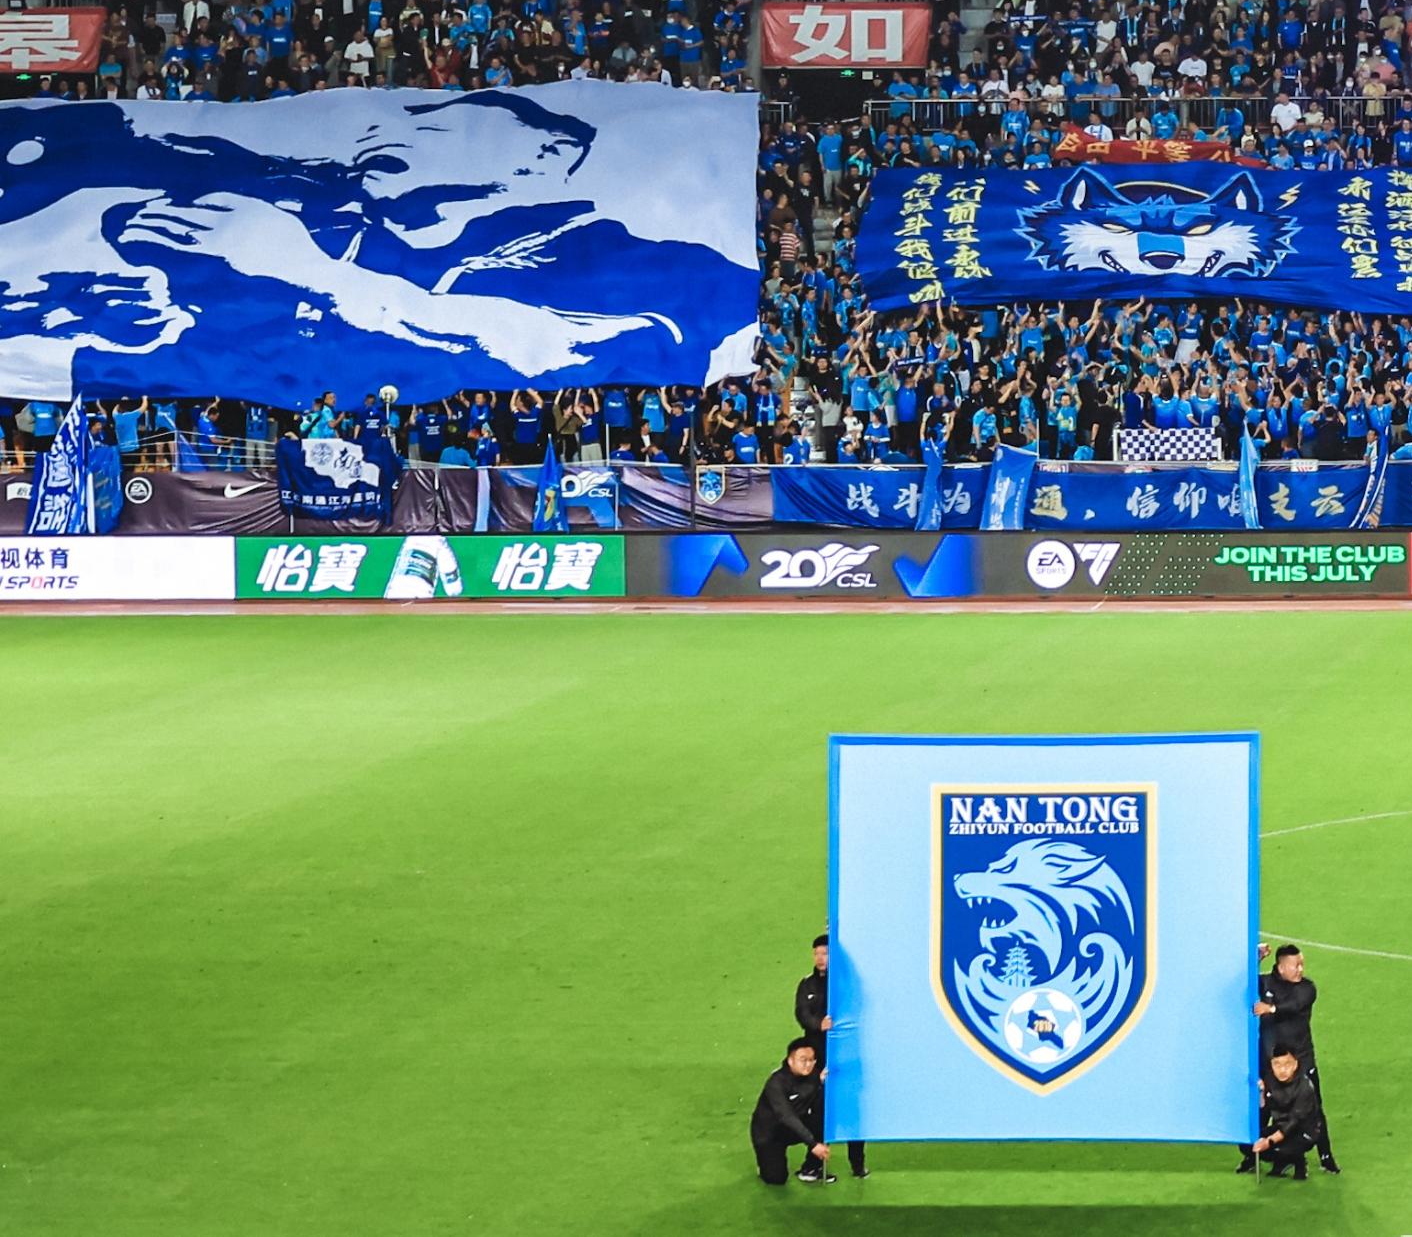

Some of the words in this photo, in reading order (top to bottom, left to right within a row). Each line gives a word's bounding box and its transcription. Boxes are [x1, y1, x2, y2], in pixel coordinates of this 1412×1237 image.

[789, 5, 903, 63] 如
[1037, 551, 1065, 566] EA
[1215, 546, 1280, 564] JOIN
[1281, 546, 1329, 564] THE
[1331, 546, 1405, 564] CLUB
[256, 543, 367, 593] 怡寶
[491, 542, 603, 591] 怡寶
[1248, 565, 1310, 582] THIS
[1311, 565, 1377, 582] JULY
[5, 575, 79, 589] SPORTS
[836, 572, 877, 588] CSL
[950, 796, 1028, 823] NAN
[1039, 796, 1139, 823] TONG
[949, 822, 1010, 835] ZHIYUN
[1013, 822, 1095, 834] FOOTBALL
[1098, 821, 1140, 834] CLUB
